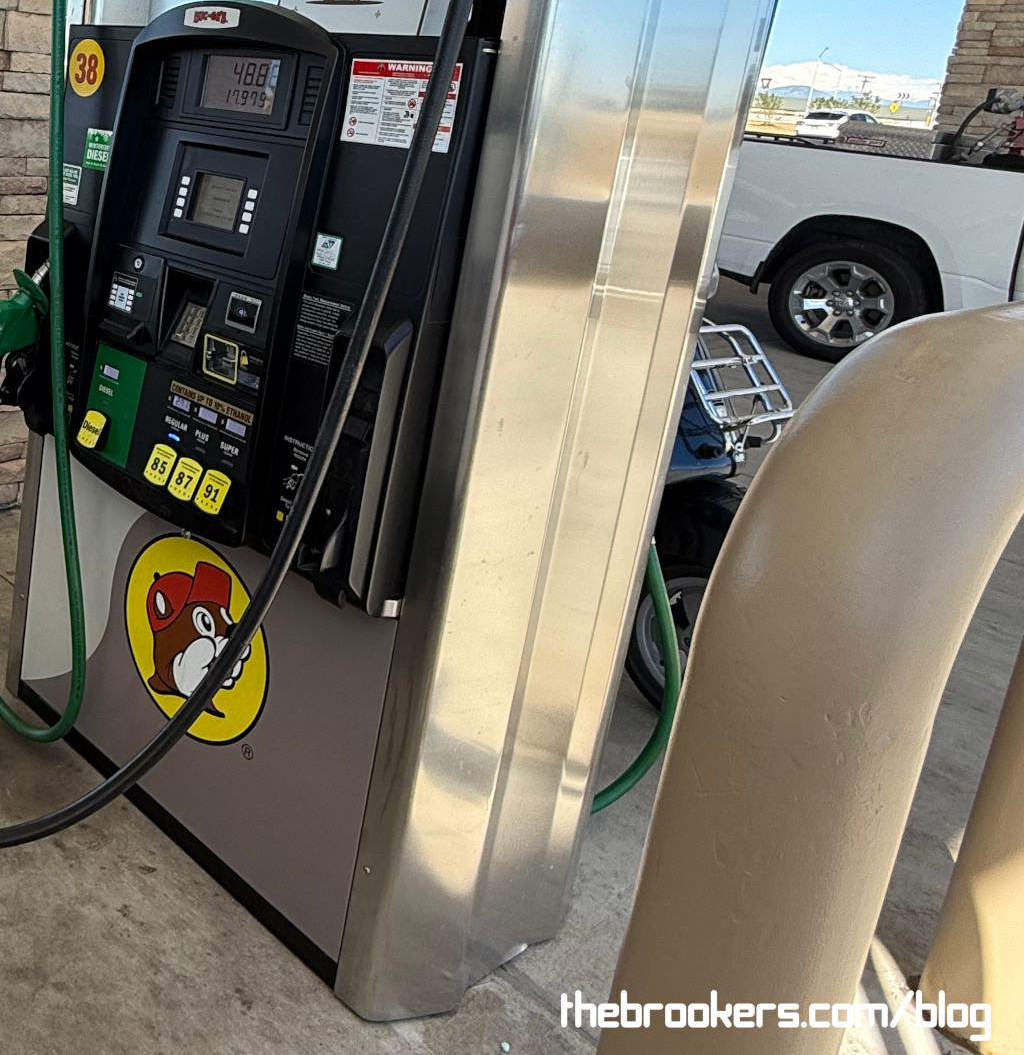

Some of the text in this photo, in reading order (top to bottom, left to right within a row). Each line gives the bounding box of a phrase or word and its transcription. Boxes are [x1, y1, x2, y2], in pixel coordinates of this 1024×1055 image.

[75, 53, 98, 85] 38
[98, 384, 114, 397] DIESEL
[171, 383, 196, 400] CONTAINS
[197, 393, 205, 402] UP
[206, 397, 213, 407] TO
[226, 406, 252, 424] ETHANOL
[82, 420, 102, 436] Diesel
[165, 415, 188, 432] REGULAR
[195, 429, 210, 442] PLUS
[220, 441, 239, 456] SUPER
[151, 457, 168, 475] 85
[175, 471, 193, 489] 87
[203, 484, 219, 503] 91
